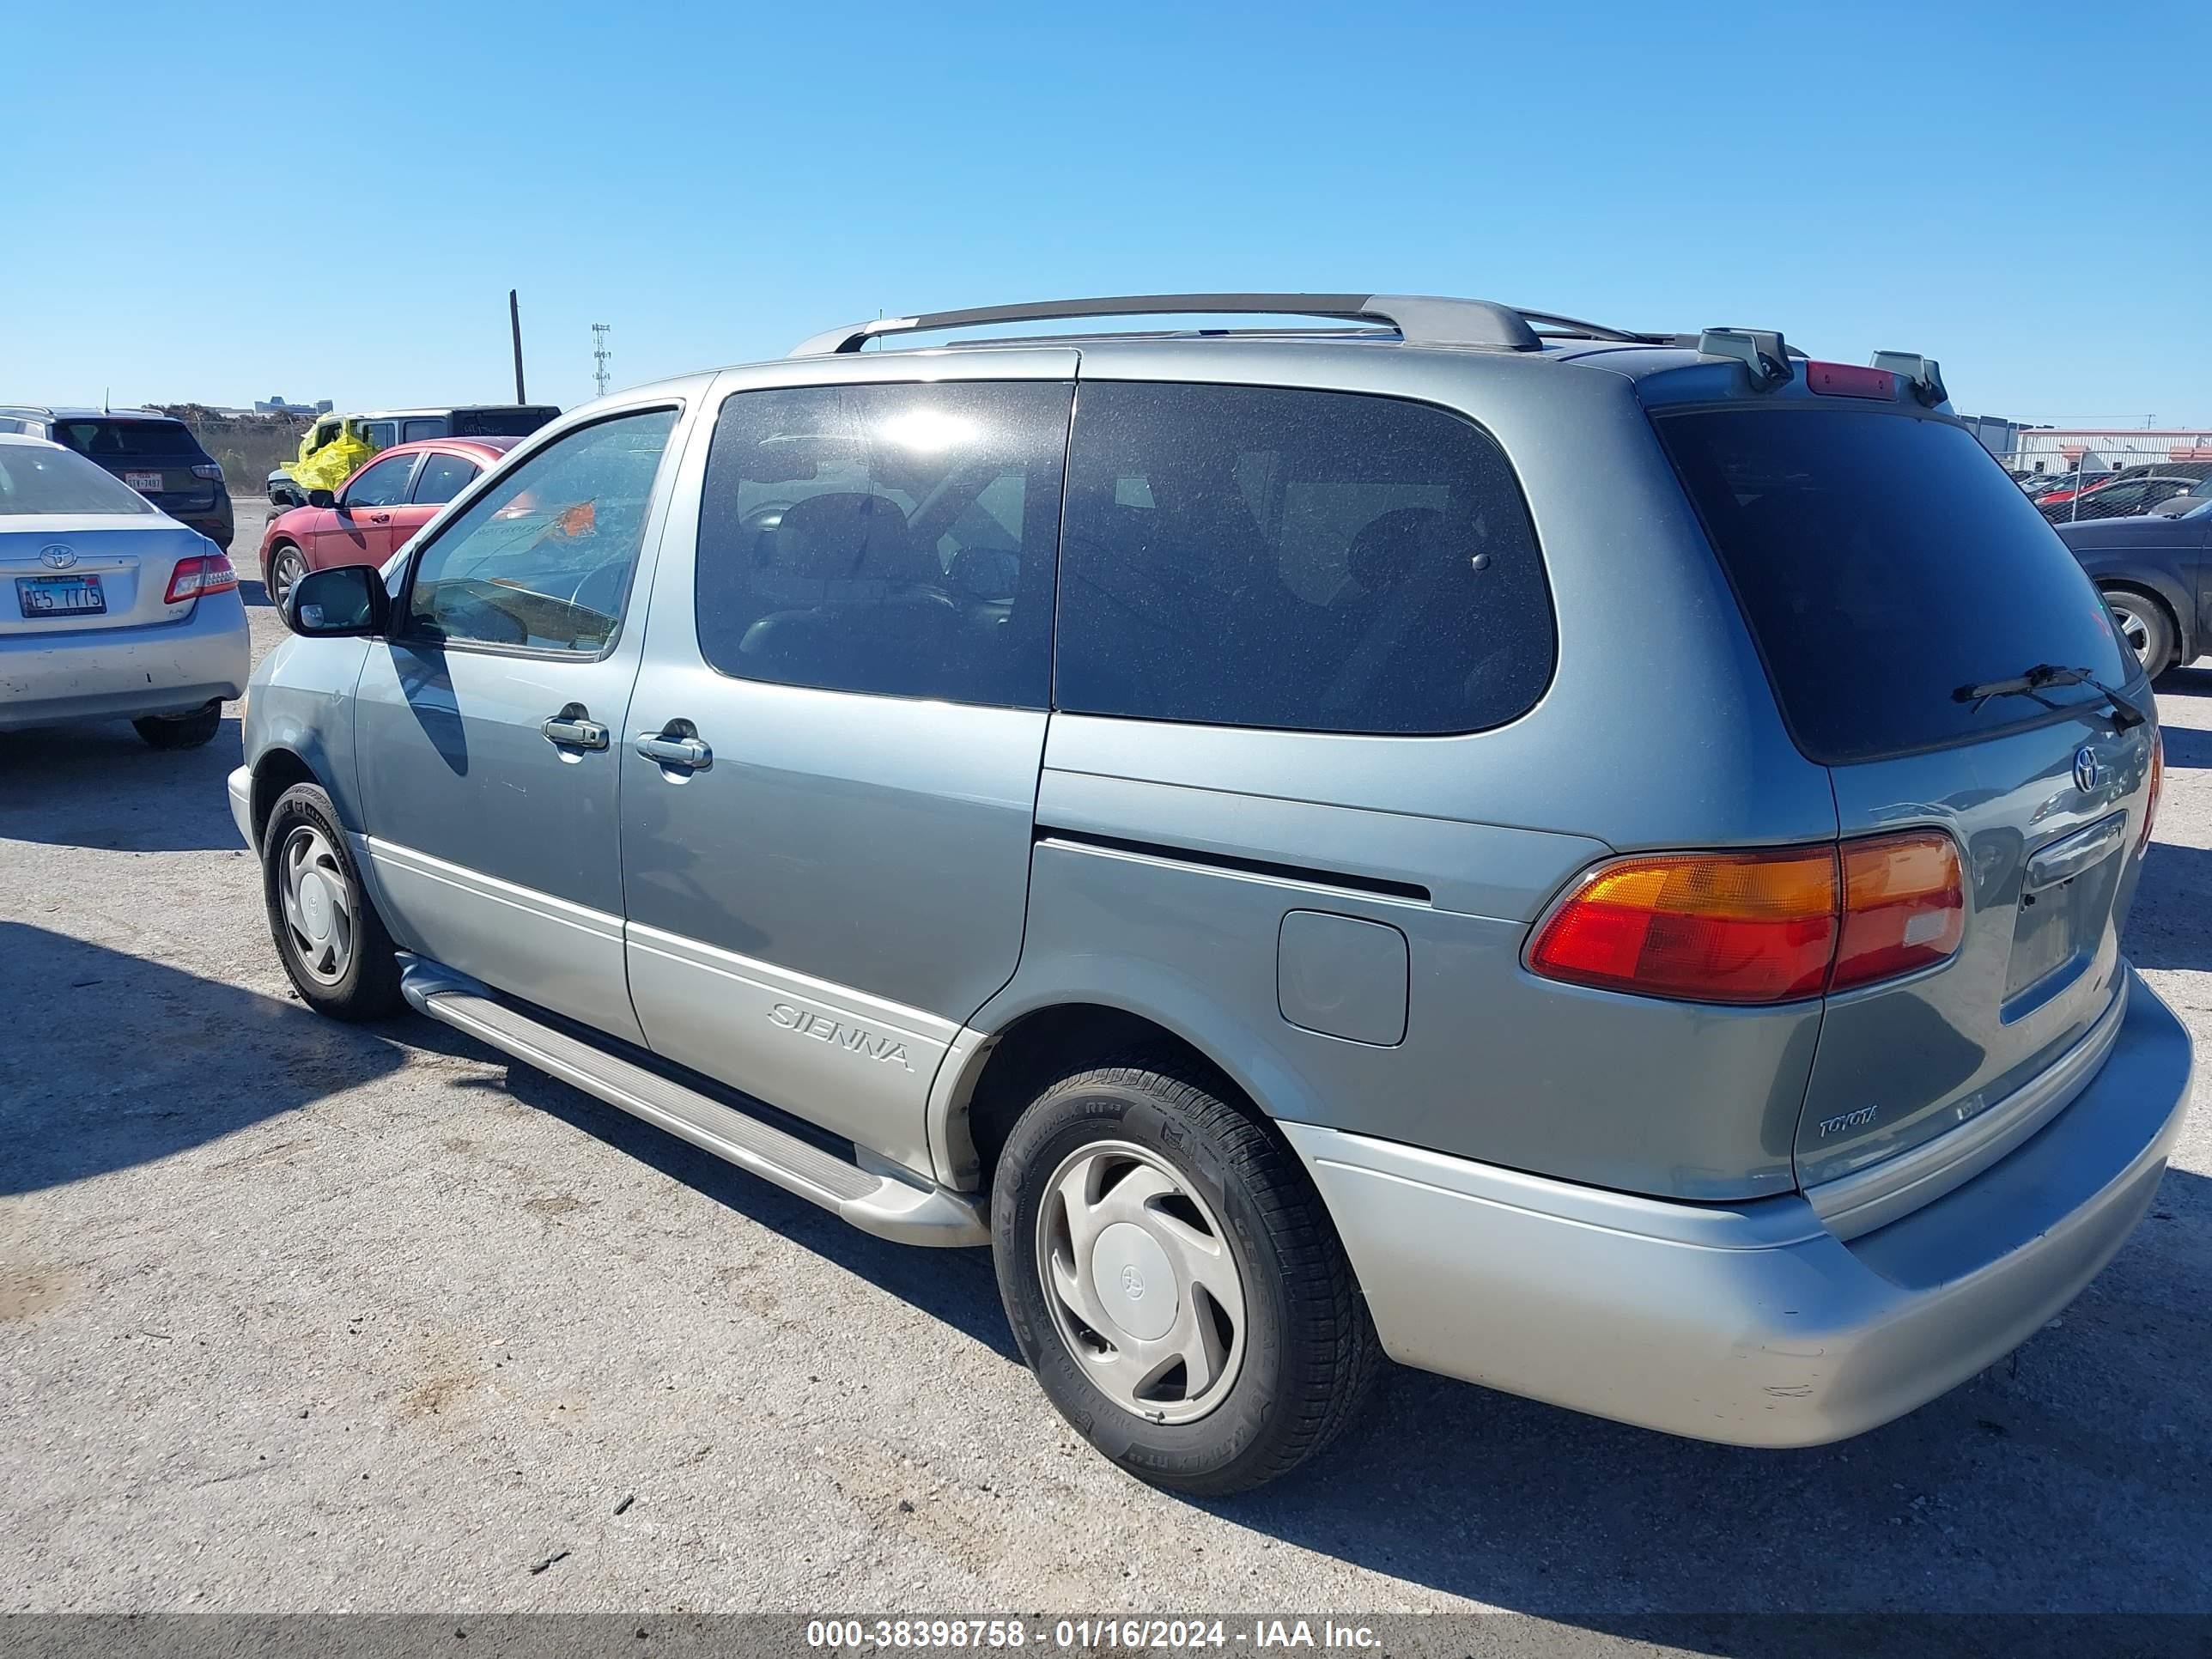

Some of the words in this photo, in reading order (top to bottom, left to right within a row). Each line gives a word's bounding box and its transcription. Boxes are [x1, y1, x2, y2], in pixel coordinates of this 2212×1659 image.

[61, 587, 100, 607] 7775
[766, 1002, 916, 1073] SIENNA
[1820, 1103, 1879, 1139] TOYOTA
